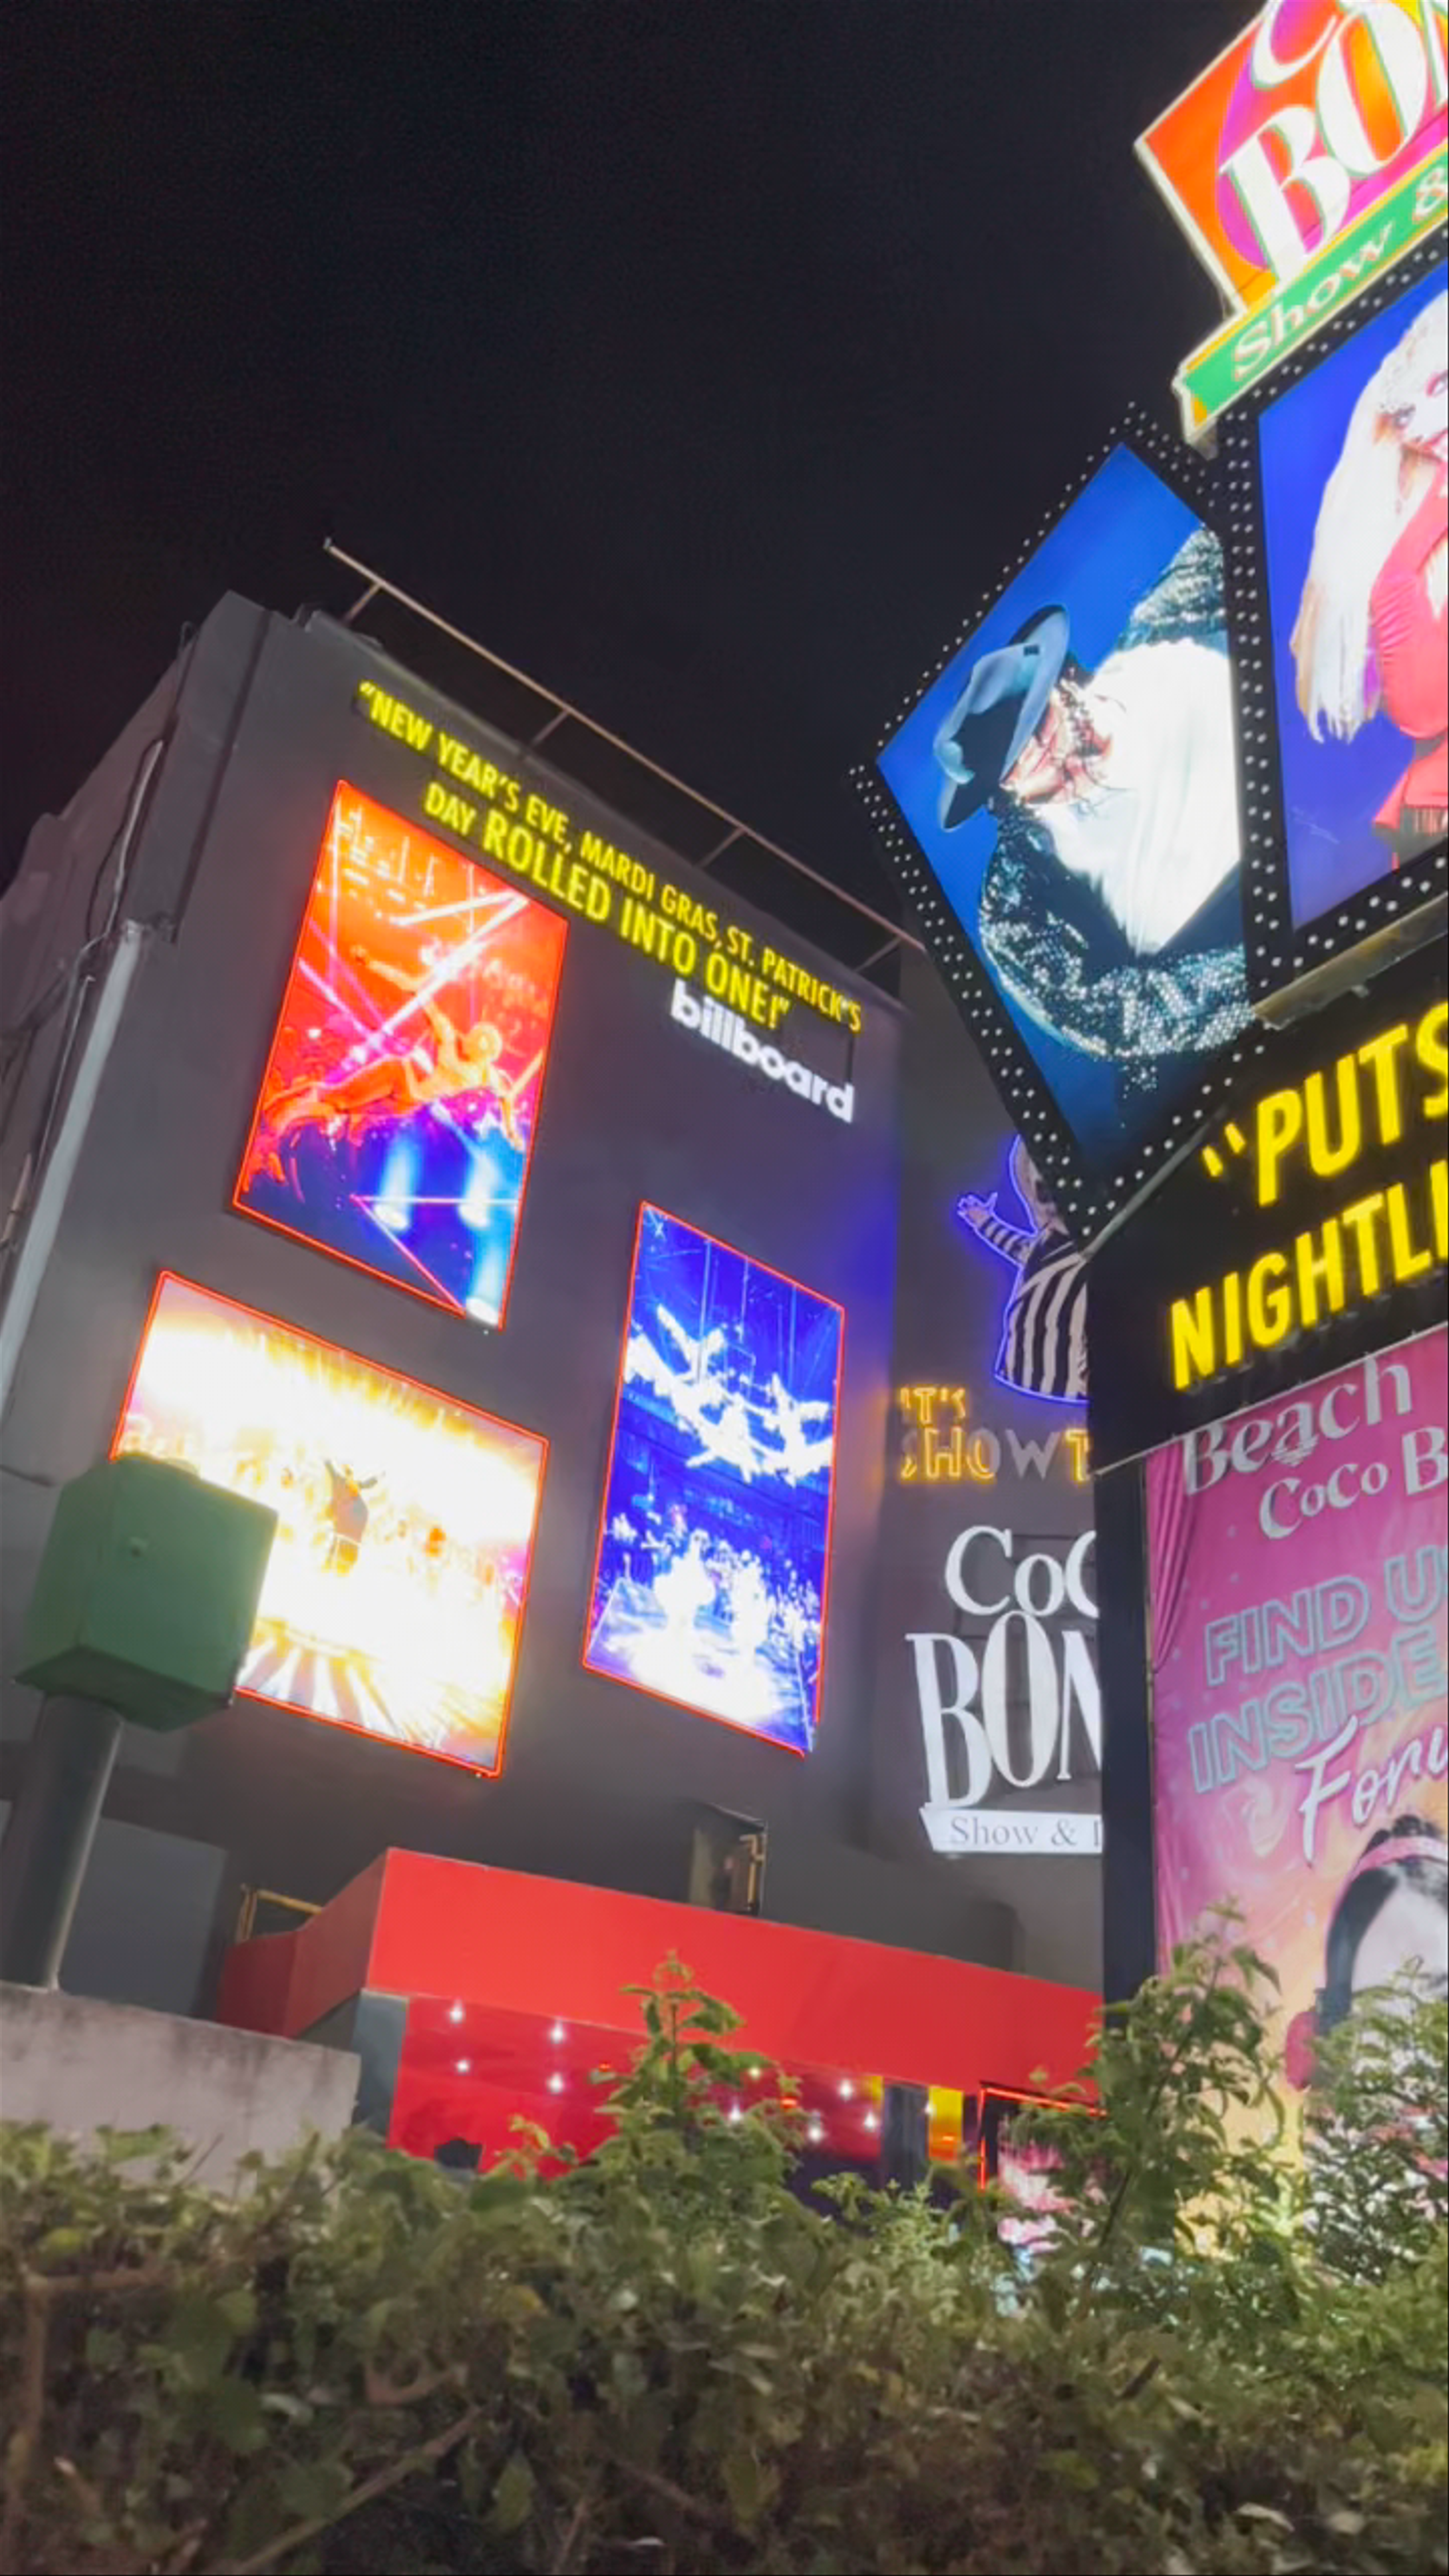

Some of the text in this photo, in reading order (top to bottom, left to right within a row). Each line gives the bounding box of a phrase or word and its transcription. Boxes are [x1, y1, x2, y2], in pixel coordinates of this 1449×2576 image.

[1232, 220, 1394, 381] Show
[359, 680, 862, 1032] "NEW YEAR'S EVE, MARDI GRAS, ST. PATRICK'S
[424, 781, 792, 1030] DAY ROLLED INTO ONE!"
[670, 977, 855, 1123] billboard
[1183, 1355, 1412, 1496] Beach
[1204, 1576, 1371, 1686] FIND
[1188, 1624, 1446, 1795] INSIDE
[950, 1816, 1038, 1846] Show
[1051, 1818, 1078, 1846] &
